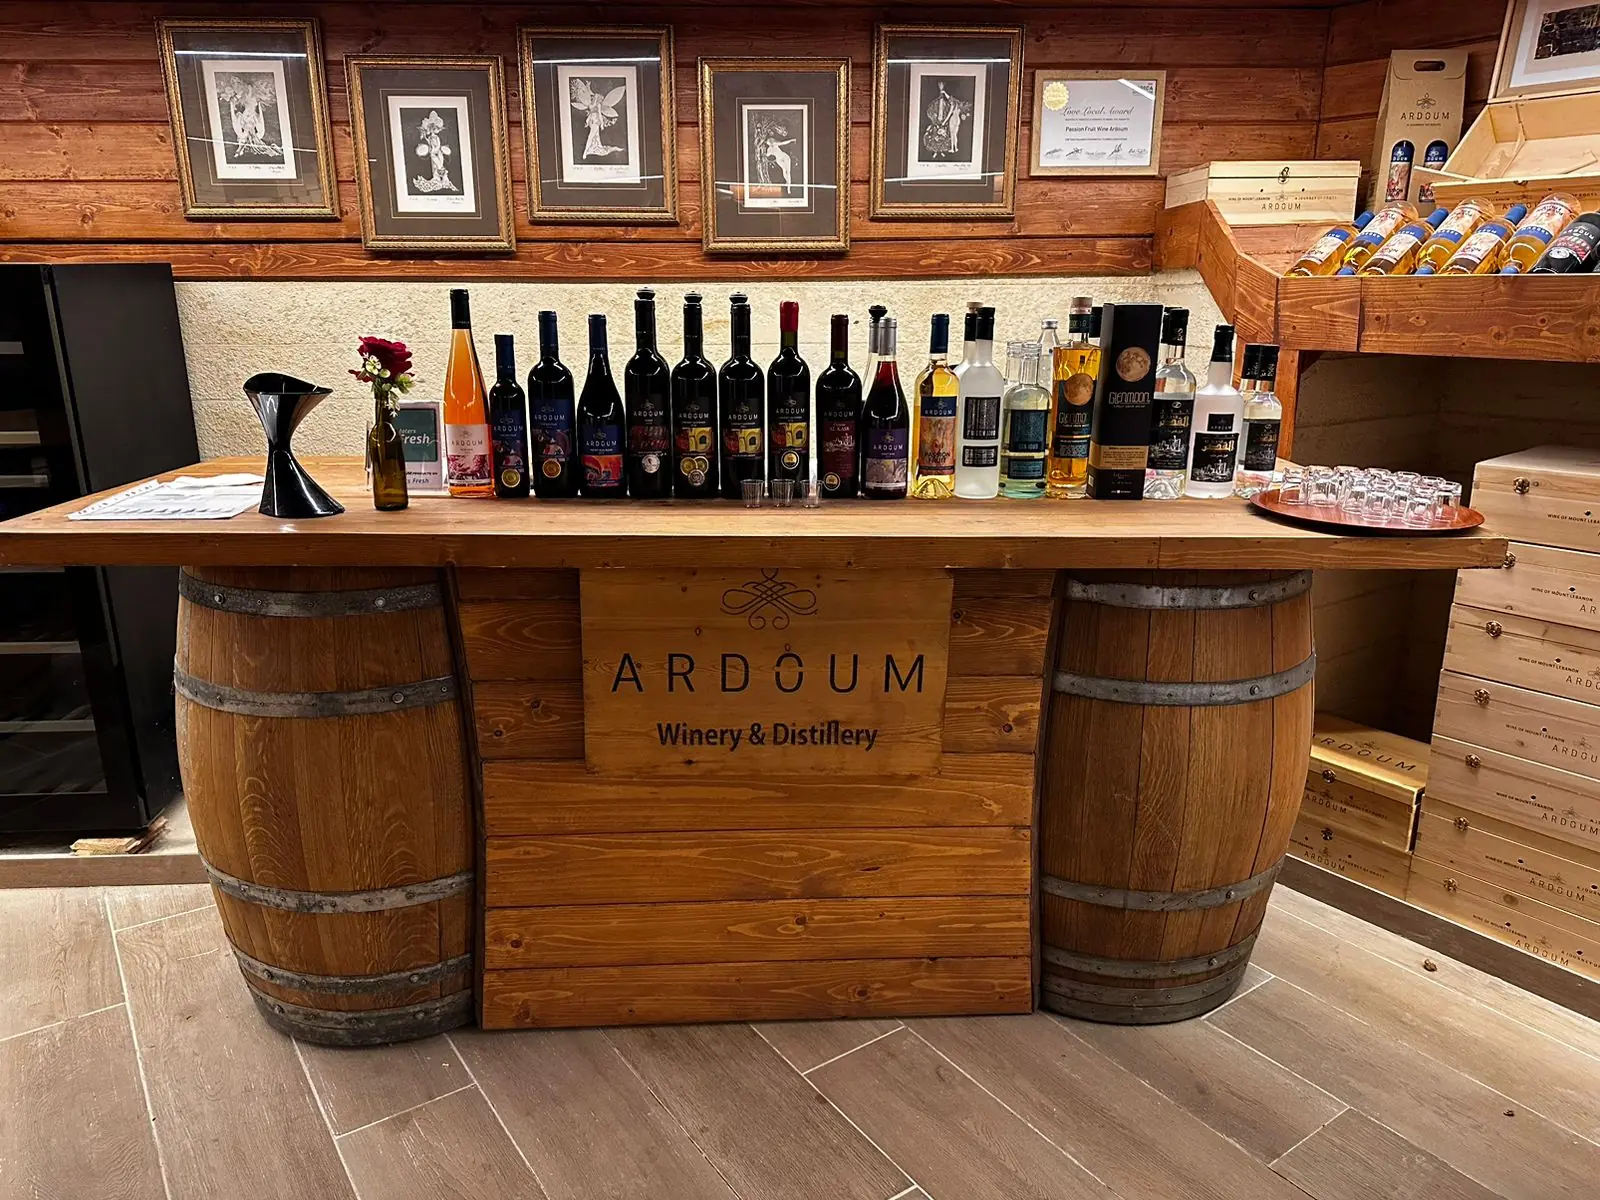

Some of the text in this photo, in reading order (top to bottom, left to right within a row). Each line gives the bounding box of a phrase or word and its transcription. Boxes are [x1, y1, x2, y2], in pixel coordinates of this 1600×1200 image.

[1400, 111, 1451, 120] ARDOUM
[1261, 202, 1301, 210] ARDOUM
[1570, 594, 1593, 602] LEBANON
[611, 652, 925, 694] ARDOUM
[1556, 665, 1579, 673] LEBANON
[657, 719, 878, 752] Winery & Distillery
[1312, 733, 1417, 771] RDOUM
[1305, 793, 1347, 814] ARDOUM
[1541, 812, 1599, 836] ARDOUM
[1304, 850, 1346, 872] ARDOUM
[1529, 877, 1585, 902] ARDOUM
[1514, 939, 1569, 966] ARDOUM
